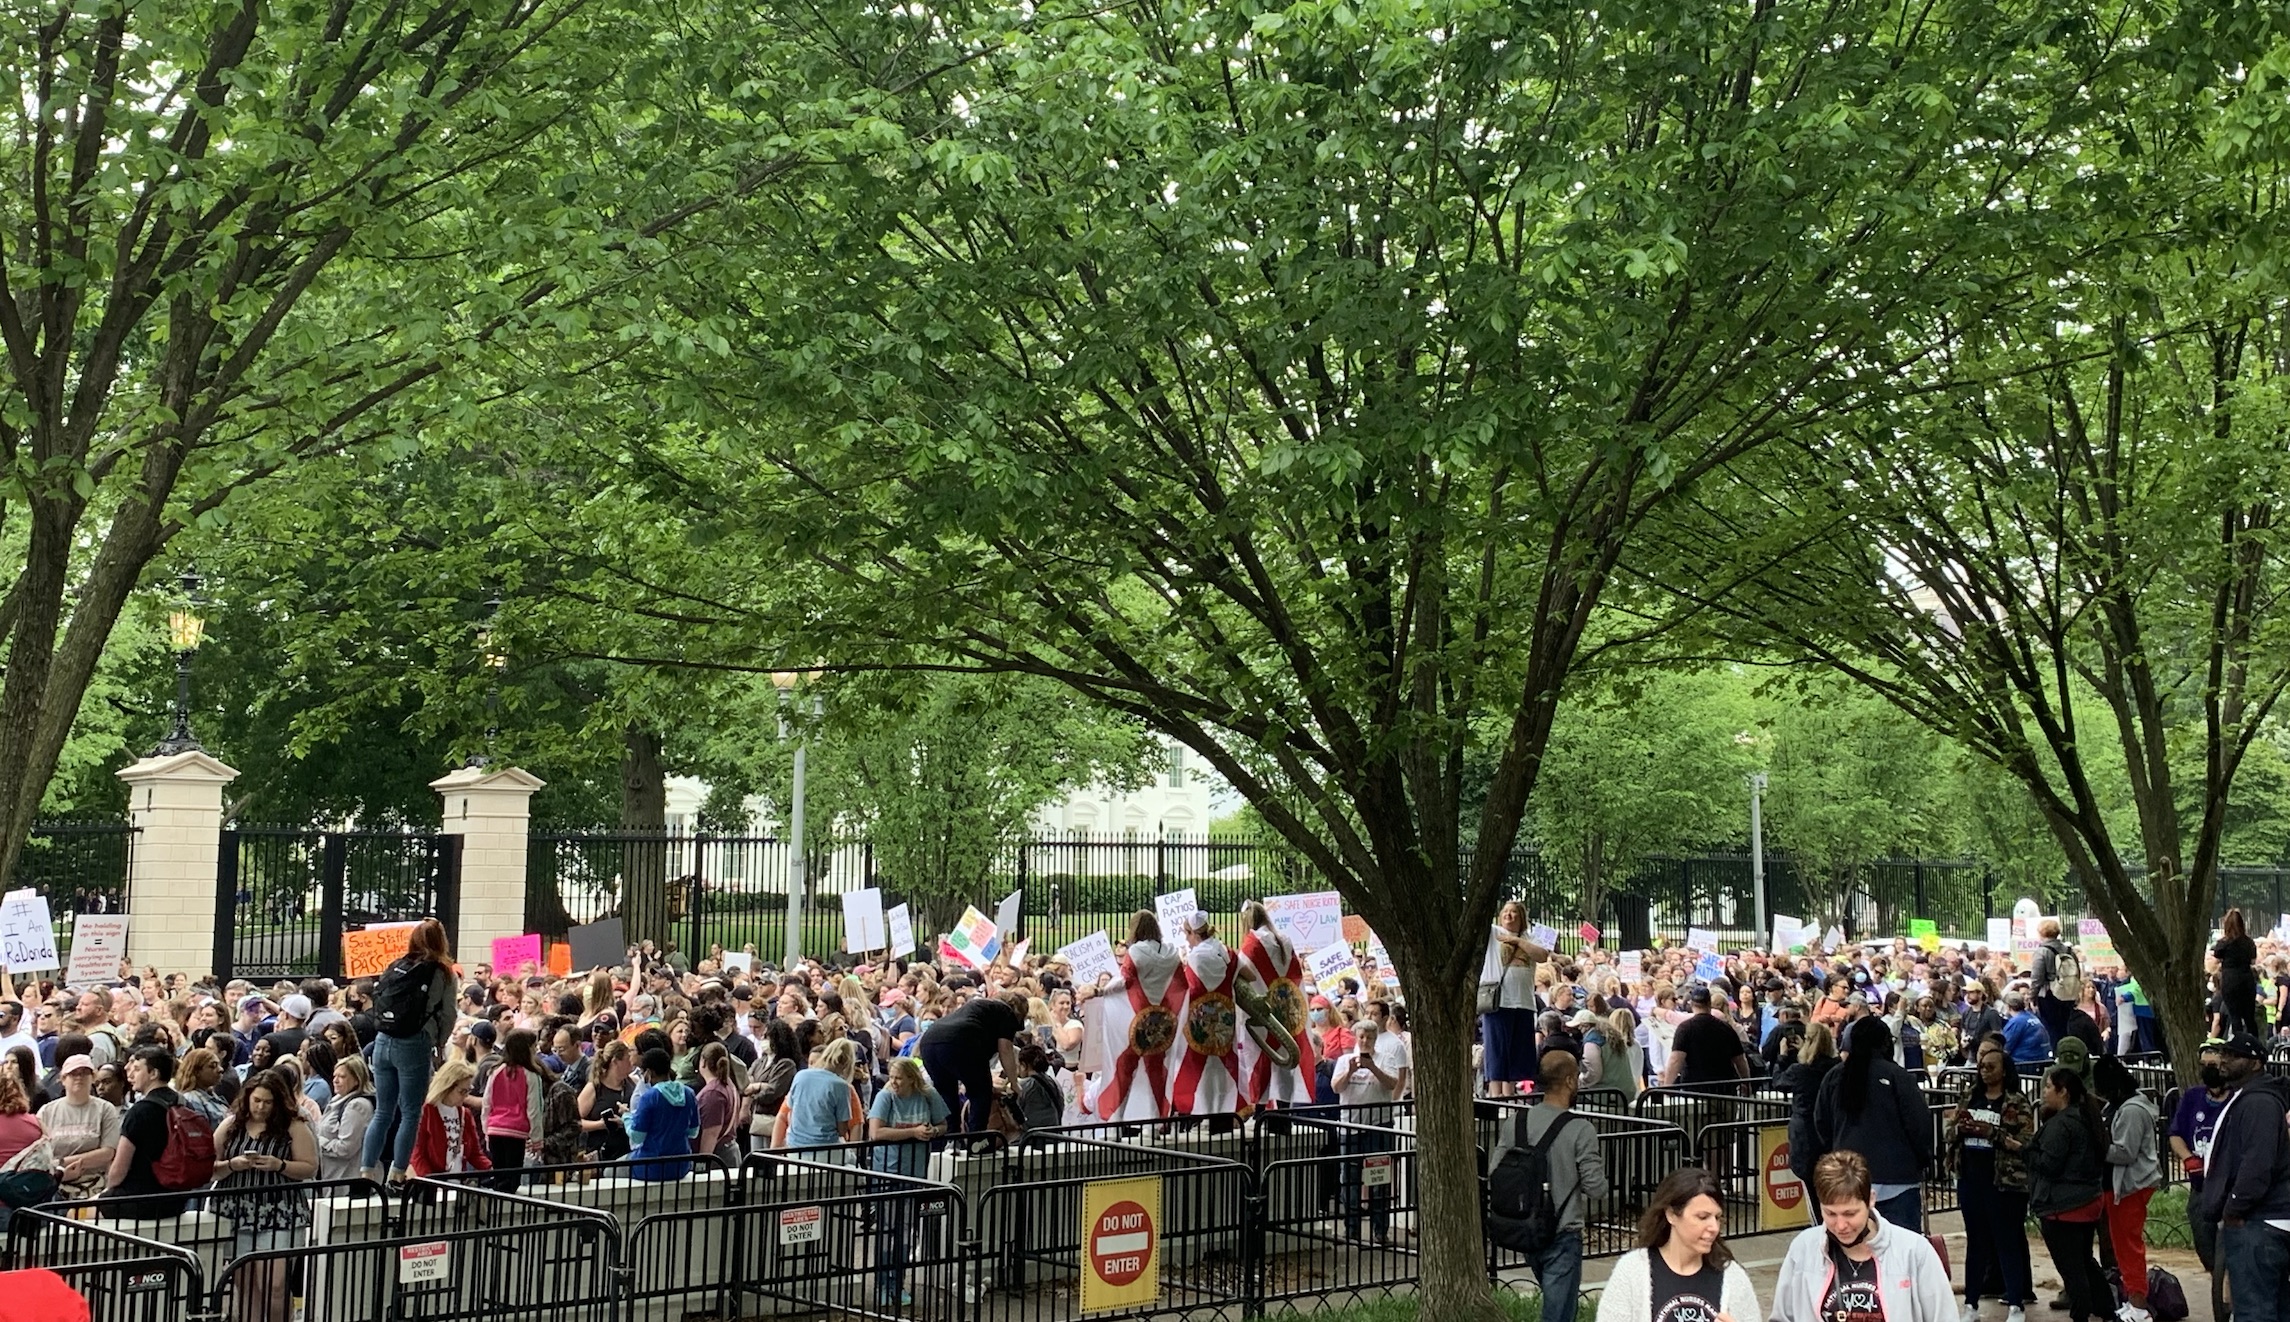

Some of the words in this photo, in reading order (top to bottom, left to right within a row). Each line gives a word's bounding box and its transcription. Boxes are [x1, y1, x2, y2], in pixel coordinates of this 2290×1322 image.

[1164, 893, 1182, 906] CAP
[1284, 899, 1301, 911] SAFE
[1162, 900, 1195, 919] RATIOS
[94, 922, 122, 931] holding
[1171, 915, 1188, 928] NOT
[1319, 915, 1339, 925] LAW
[5, 923, 19, 937] I
[27, 919, 45, 933] Am
[105, 930, 121, 938] sign
[1171, 926, 1185, 939] PA
[2017, 940, 2041, 949] PEOP
[4, 938, 54, 965] RaDonda
[1063, 942, 1095, 961] RACISM
[73, 954, 103, 963] carrying
[1319, 951, 1344, 970] SAFE
[1701, 952, 1721, 969] SAFE
[80, 969, 106, 978] System
[1081, 963, 1108, 984] CRISIS
[1314, 957, 1354, 981] STAFFING
[1773, 1154, 1785, 1167] DO
[1775, 1186, 1800, 1200] ENTER
[787, 1225, 798, 1234] DO
[799, 1223, 813, 1231] NOT
[1103, 1215, 1119, 1232] DO
[1121, 1213, 1144, 1230] NOT
[788, 1231, 812, 1241] ENTER
[411, 1260, 422, 1269] DO
[424, 1258, 437, 1268] NOT
[1104, 1256, 1140, 1275] ENTER
[413, 1269, 435, 1278] ENTER
[1851, 1282, 1877, 1292] NURSES
[1680, 1295, 1705, 1307] NURSES
